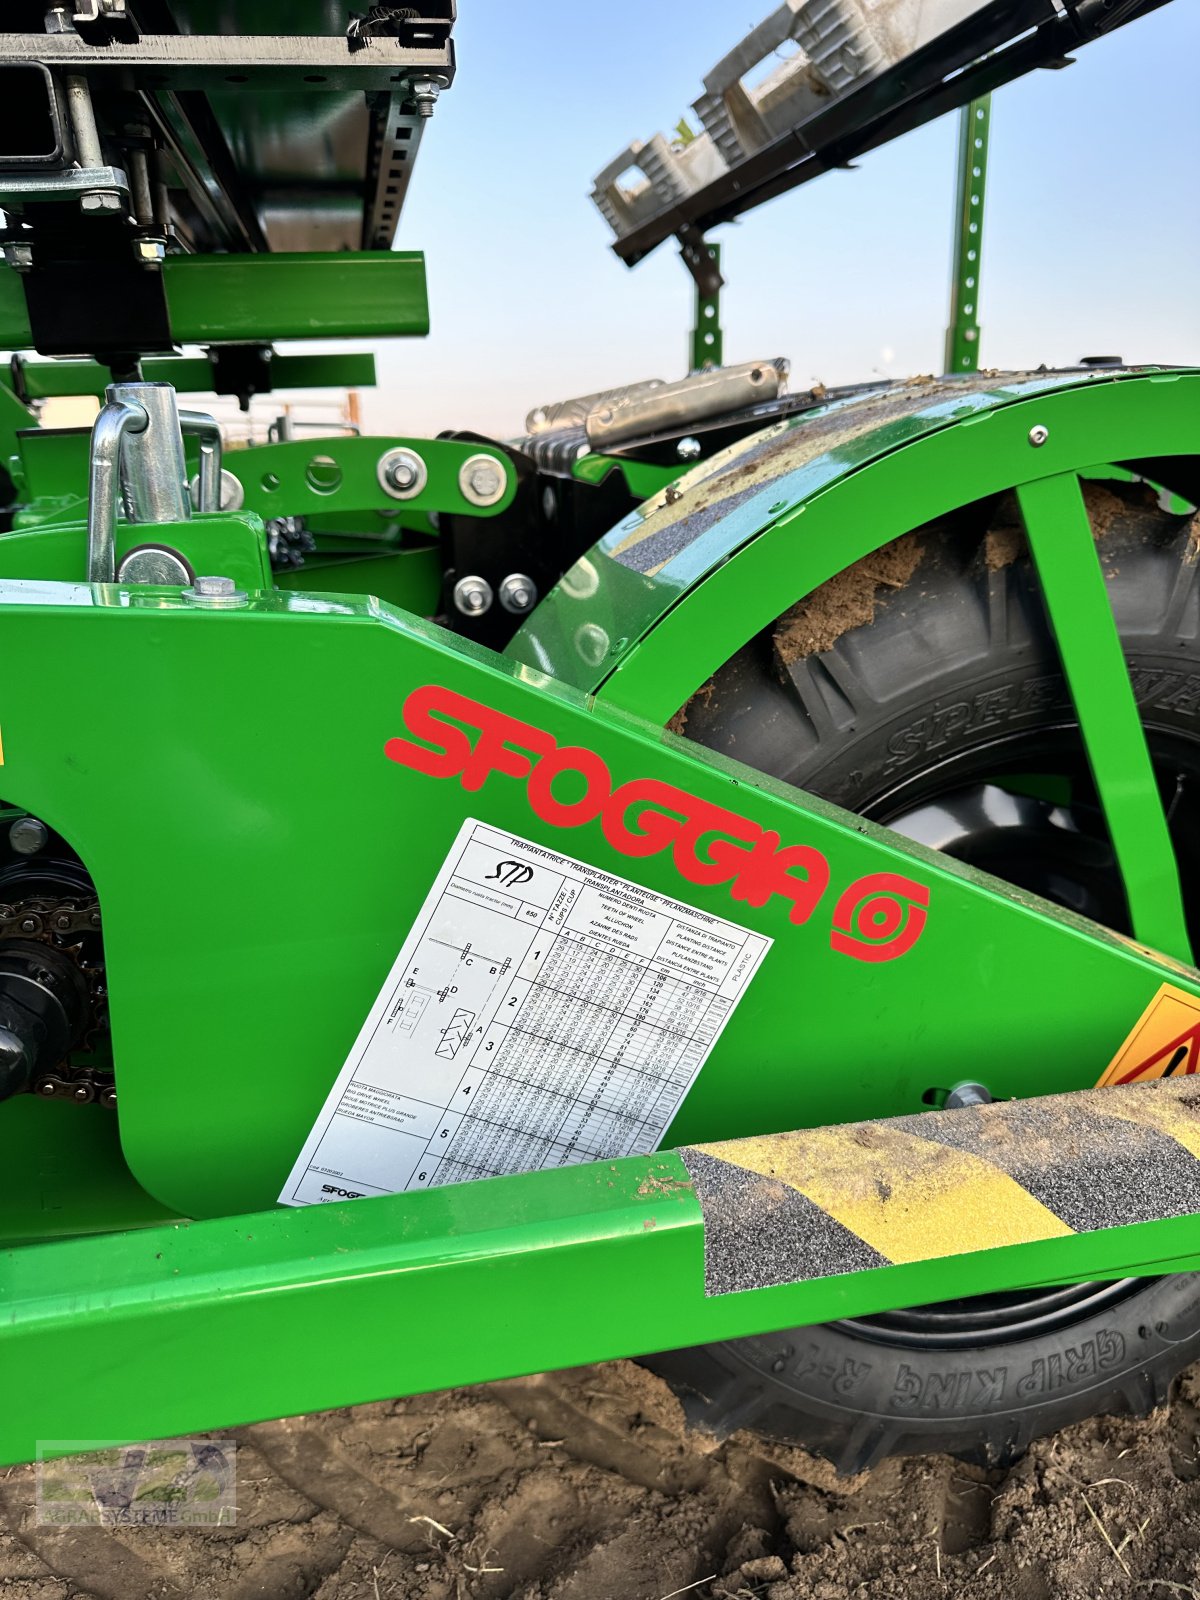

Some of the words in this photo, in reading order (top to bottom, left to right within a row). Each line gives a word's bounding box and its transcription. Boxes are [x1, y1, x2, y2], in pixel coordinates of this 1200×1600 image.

[384, 685, 829, 925] SFOGGIA
[485, 861, 533, 887] STP
[510, 839, 565, 865] TRAPIANTATRICE
[569, 862, 618, 886] TRANSPLANTER
[622, 883, 658, 902] PLANTEUSE
[662, 899, 715, 924] PFLANZMASCHINE
[582, 877, 644, 905] TRANSPLANTADORA
[552, 892, 566, 912] TAZZE
[554, 908, 567, 925] CUPS
[565, 888, 577, 904] CUP
[598, 892, 621, 904] NUMERO
[621, 901, 638, 911] DENTI
[638, 908, 656, 918] RUOTA
[600, 903, 618, 913] TEETH
[626, 913, 645, 924] WHEEL
[604, 915, 633, 929] ALLUCHON
[588, 929, 611, 941] DIENTES
[611, 938, 630, 948] RUEDA
[676, 923, 701, 936] DISTANZA
[707, 935, 735, 949] TRAPIANTO
[676, 933, 701, 946] PLANTING
[701, 943, 726, 956] DISTANCE
[532, 949, 540, 960] 1
[665, 939, 690, 952] DISTANCE
[690, 948, 707, 958] ENTRE
[707, 955, 727, 966] PLANTS
[464, 958, 473, 966] C
[489, 966, 497, 974] B
[656, 955, 682, 968] DISTANCIA
[682, 965, 699, 975] ENTRE
[699, 972, 719, 982] PLANTS
[731, 952, 752, 982] PLASTIC
[449, 985, 458, 994] D
[652, 980, 664, 988] 120
[692, 979, 705, 988] inch
[508, 996, 517, 1007] 2
[475, 1025, 483, 1033] A
[485, 1042, 494, 1051] 3
[349, 1082, 367, 1090] RUOTA
[367, 1087, 401, 1100] MAGGIORATA
[462, 1086, 471, 1094] 4
[358, 1099, 381, 1109] MOTRICE
[395, 1110, 417, 1119] GRANDE
[372, 1096, 390, 1104] WHEEL
[337, 1107, 355, 1115] RUEDA
[355, 1112, 374, 1121] MAYOR
[369, 1109, 404, 1123] ANTRIEBSRAD
[440, 1129, 449, 1138] 5
[418, 1172, 427, 1181] 6
[1016, 1329, 1126, 1398] GRIP
[890, 1364, 1007, 1408] KING
